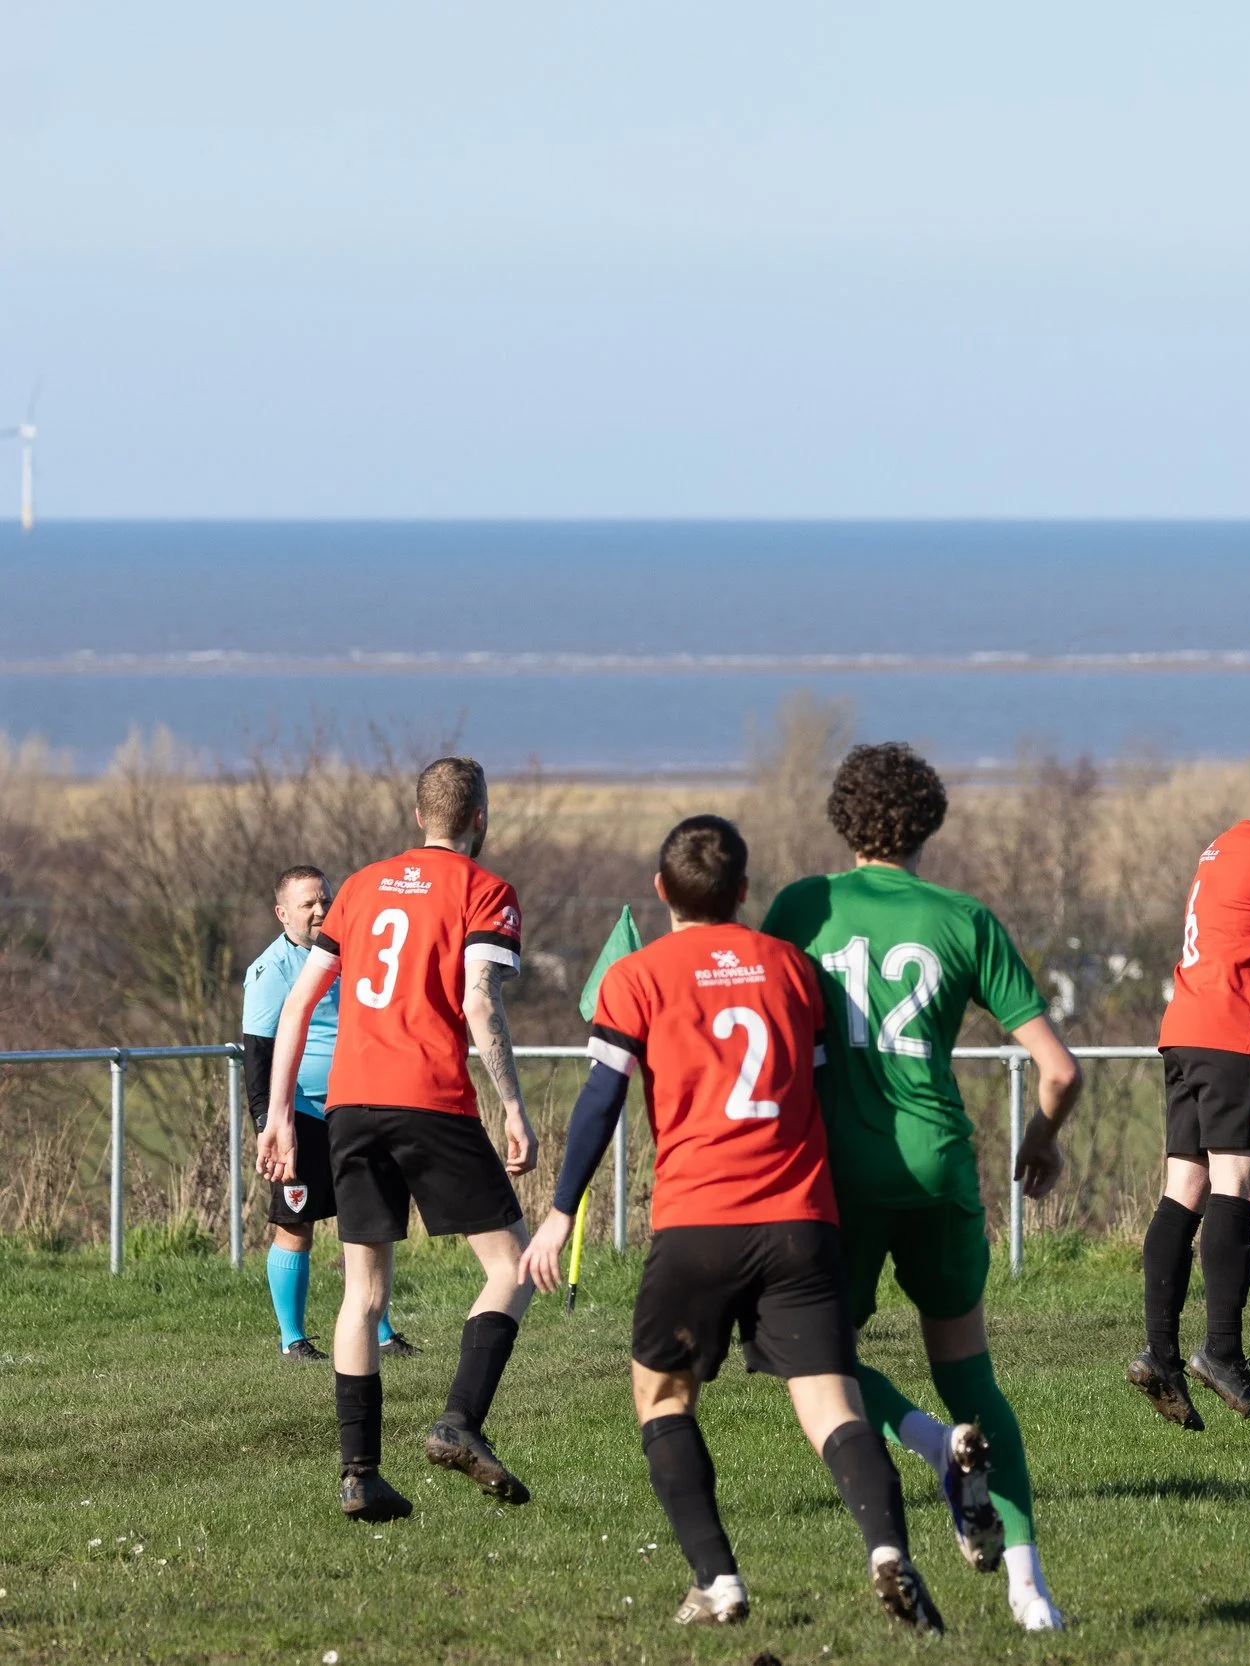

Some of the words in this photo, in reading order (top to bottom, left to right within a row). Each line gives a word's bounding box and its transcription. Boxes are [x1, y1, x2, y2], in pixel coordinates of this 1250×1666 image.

[381, 878, 394, 886] RG
[394, 879, 432, 889] HOWELLS
[355, 908, 410, 1009] 3
[712, 964, 765, 978] HOWELLS
[821, 935, 943, 1059] 12
[712, 1006, 780, 1120] 2
